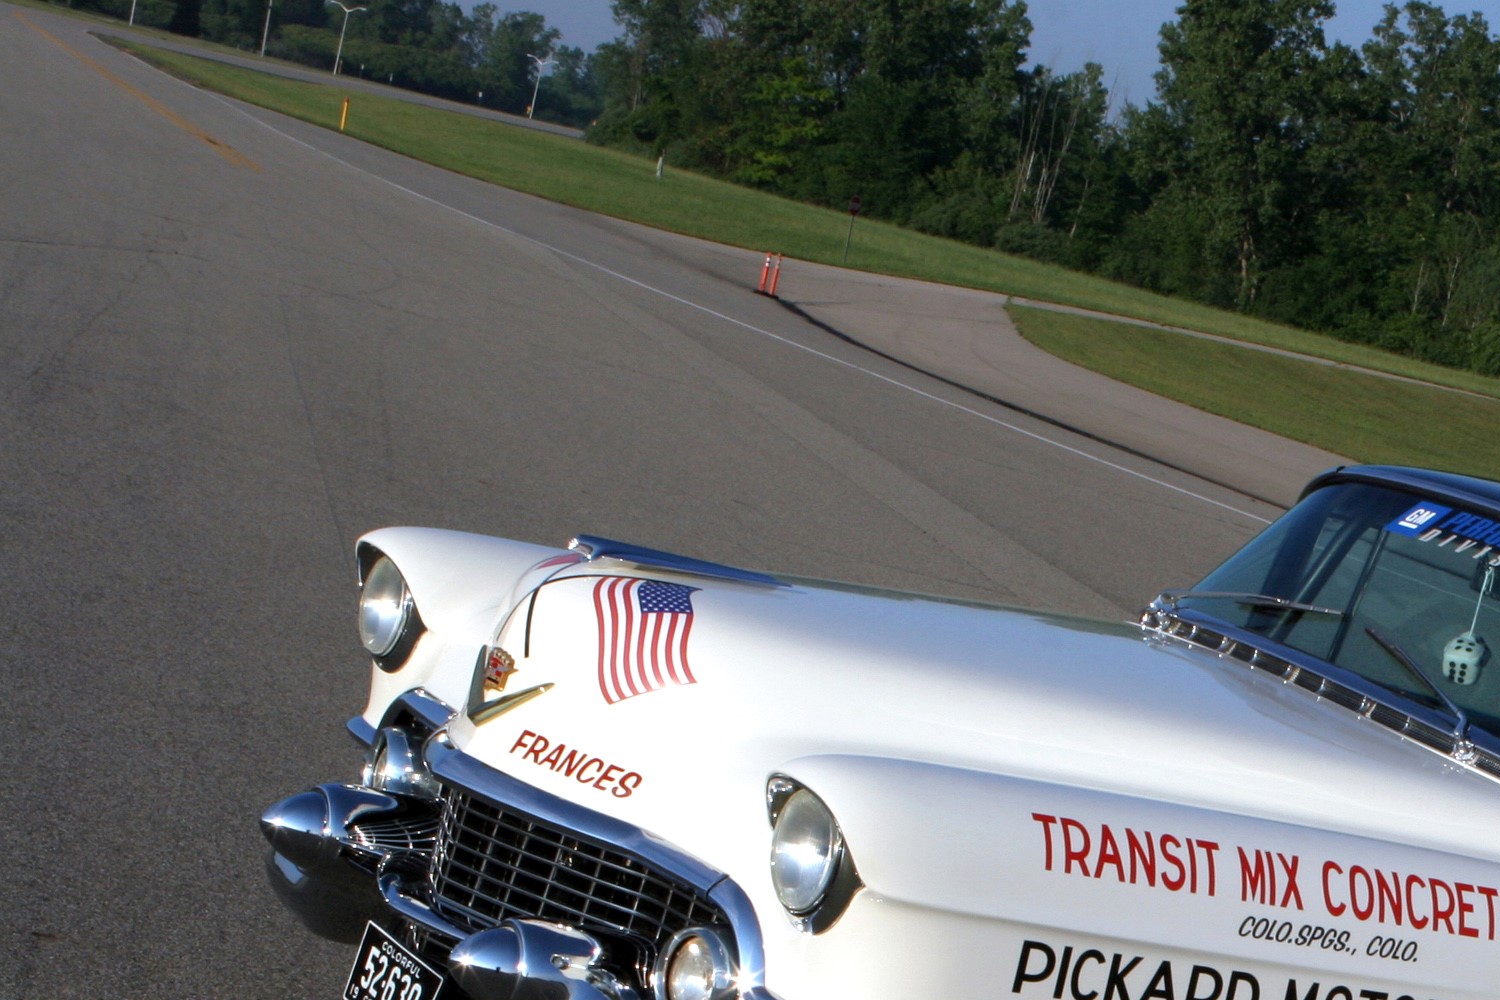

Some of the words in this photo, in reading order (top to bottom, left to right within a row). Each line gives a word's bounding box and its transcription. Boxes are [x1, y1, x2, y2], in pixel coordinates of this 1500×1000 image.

[1406, 508, 1436, 525] GM
[509, 729, 642, 798] FRANCES
[1032, 812, 1219, 897] TRANSIT
[1237, 846, 1304, 911] MIX
[382, 941, 420, 979] COLORFUL
[1366, 937, 1418, 962] COLO.
[350, 983, 359, 999] 19
